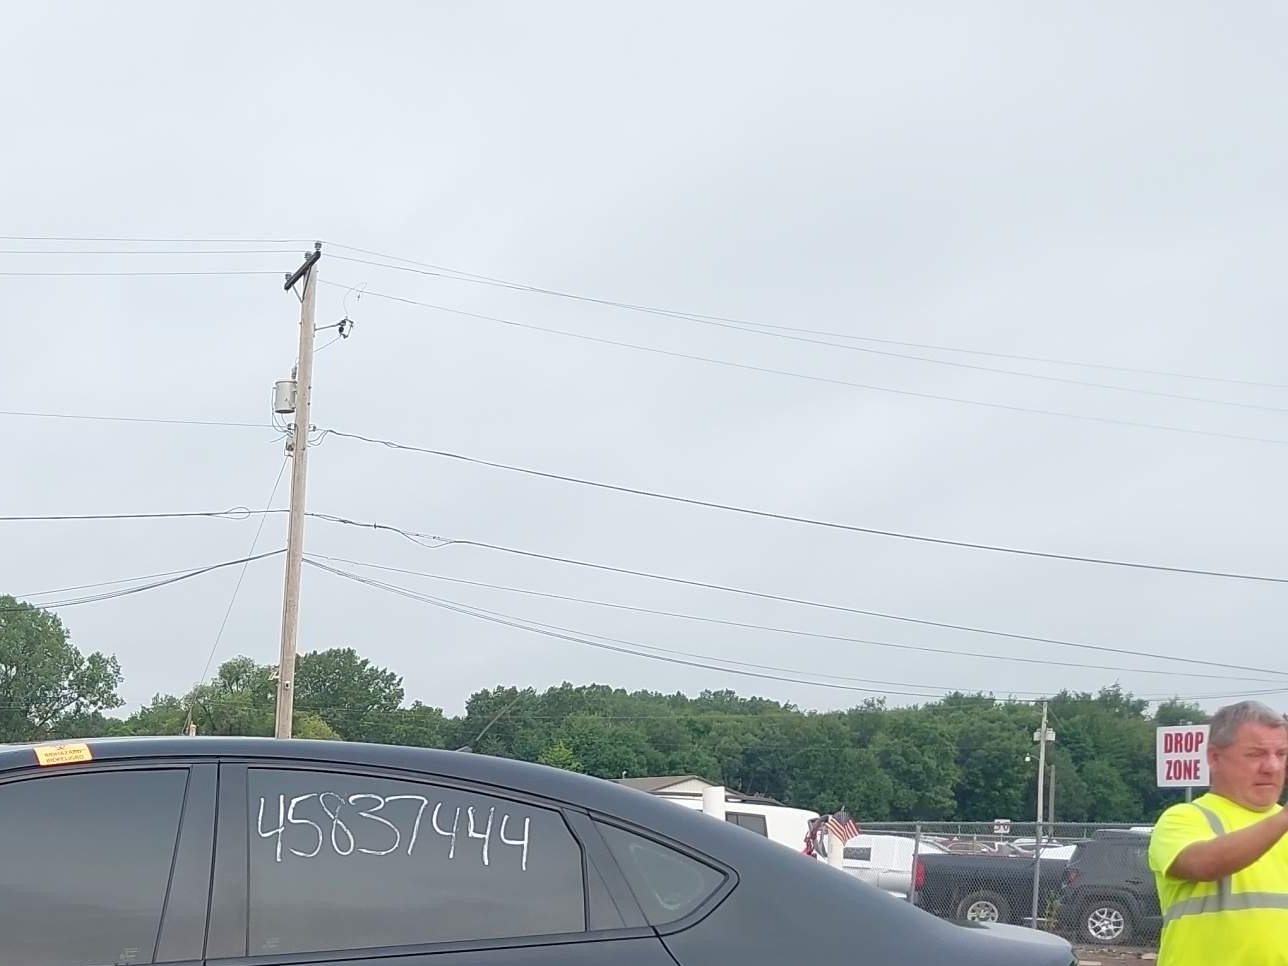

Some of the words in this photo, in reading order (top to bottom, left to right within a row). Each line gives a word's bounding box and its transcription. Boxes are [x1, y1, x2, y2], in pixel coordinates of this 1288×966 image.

[1163, 731, 1204, 753] DROP
[1165, 759, 1201, 781] ZONE
[257, 792, 530, 870] 45837444
